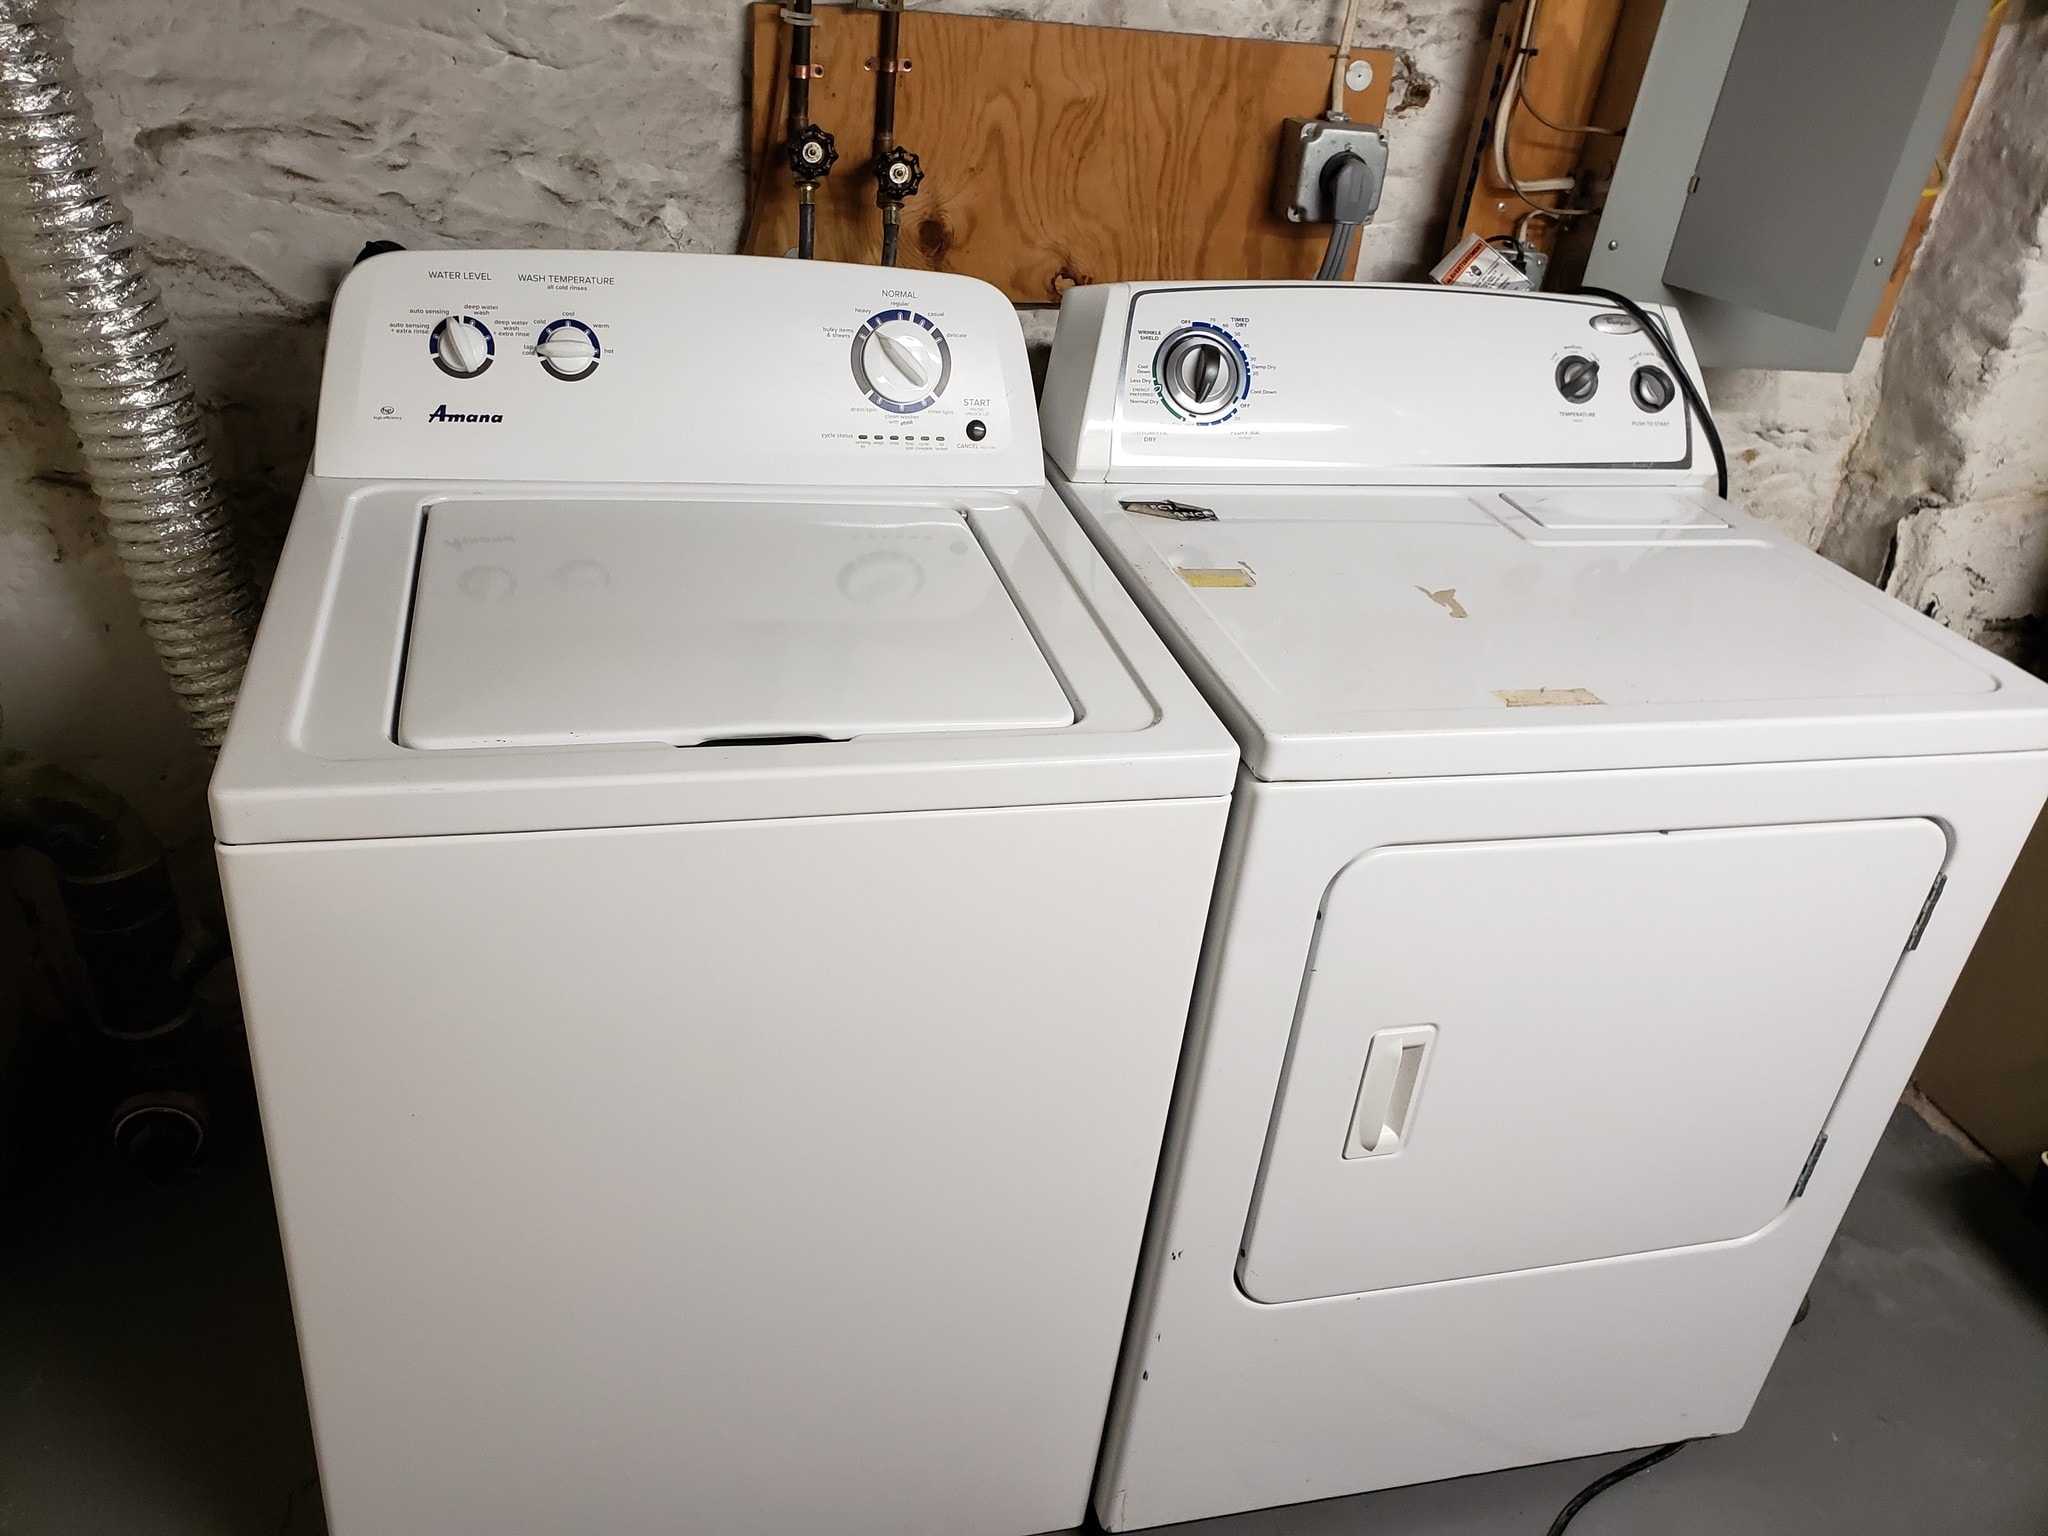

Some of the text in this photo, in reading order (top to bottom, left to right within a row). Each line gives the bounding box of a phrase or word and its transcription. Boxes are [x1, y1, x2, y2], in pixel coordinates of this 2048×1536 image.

[428, 271, 492, 281] WATER LEVEL
[517, 274, 615, 285] WASH TEMPERATURE
[881, 289, 917, 299] NORMAL
[854, 307, 872, 315] heavy
[963, 398, 991, 407] START
[428, 404, 503, 423] Amana
